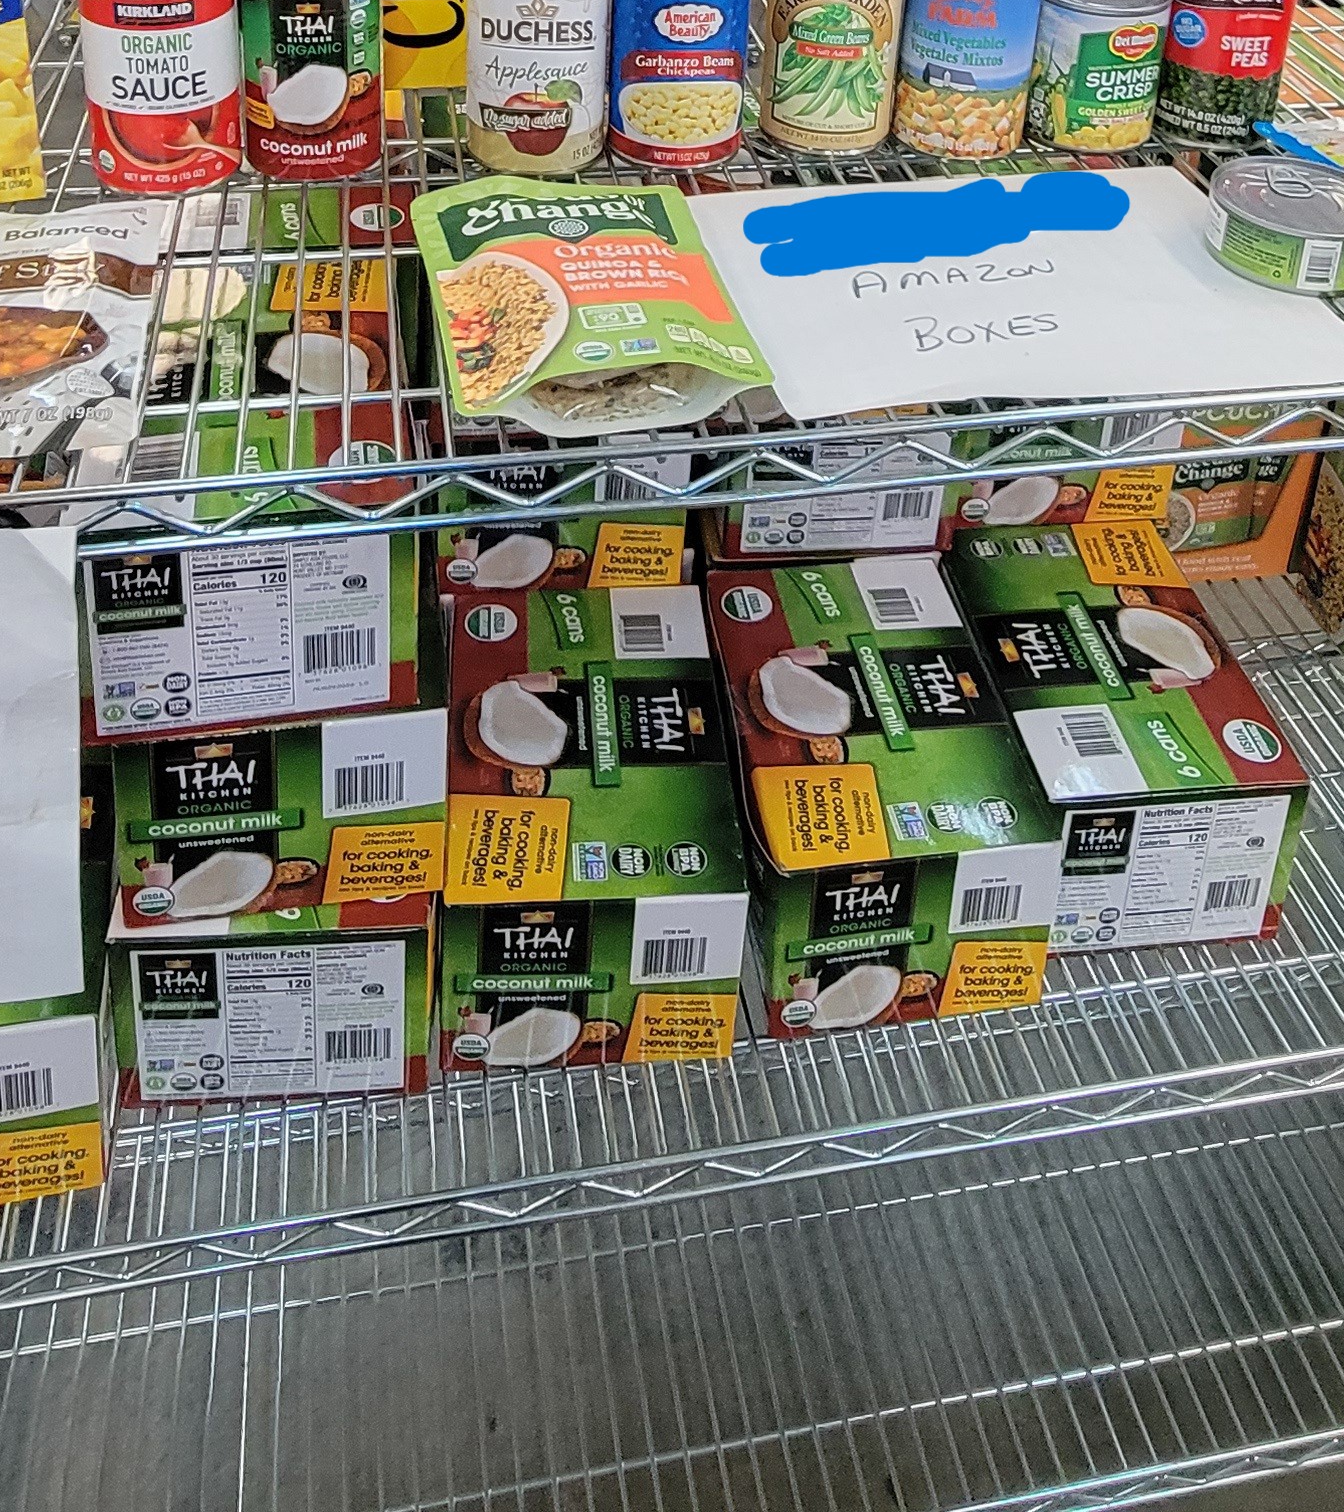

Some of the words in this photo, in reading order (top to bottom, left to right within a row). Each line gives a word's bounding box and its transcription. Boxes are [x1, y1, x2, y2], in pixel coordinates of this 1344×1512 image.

[116, 2, 193, 18] KIRKLAND
[664, 10, 716, 24] American
[279, 15, 334, 36] THAI
[481, 17, 594, 44] DUCHESS
[669, 23, 710, 37] Beauty
[121, 33, 193, 54] ORGANIC
[276, 42, 342, 55] ORGANIC
[286, 35, 332, 43] KITCHEN
[942, 31, 1007, 52] Vegetables
[1220, 35, 1271, 52] SWEET
[125, 55, 189, 75] TOMATO
[635, 55, 699, 68] Garbanzo
[704, 56, 735, 67] Beans
[963, 52, 1004, 66] Mixtos
[1231, 52, 1269, 67] PEAS
[485, 55, 588, 88] Applesauce
[657, 66, 716, 76] Chickpeas
[1085, 66, 1160, 87] SUMMER
[111, 70, 208, 102] SAUCE
[1095, 85, 1152, 101] CRISP
[498, 111, 531, 130] sugar
[533, 108, 568, 127] added
[1078, 107, 1115, 117] GOLDEN
[260, 137, 333, 157] coconut
[336, 131, 368, 154] milk
[5, 224, 129, 242] Balanced
[559, 260, 643, 271] QUINOA
[569, 282, 611, 292] WITH
[850, 258, 1057, 300] AMAZON
[904, 312, 1060, 353] BOXES
[100, 566, 172, 591] THAI
[192, 578, 238, 591] Calories
[259, 571, 287, 585] 120
[857, 645, 893, 705] coconut
[879, 705, 907, 737] milk
[165, 759, 256, 790] THAI
[1144, 807, 1185, 818] Nutrition
[1188, 805, 1213, 816] Facts
[148, 816, 236, 837] coconut
[241, 812, 283, 829] milk
[825, 883, 900, 912] THAI
[492, 926, 574, 951] THAI
[802, 936, 876, 955] coconut
[880, 928, 915, 944] milk
[226, 952, 276, 962] Nutrition
[279, 950, 312, 960] Facts
[146, 970, 207, 988] THAI
[472, 976, 551, 989] coconut
[555, 975, 594, 988] milk
